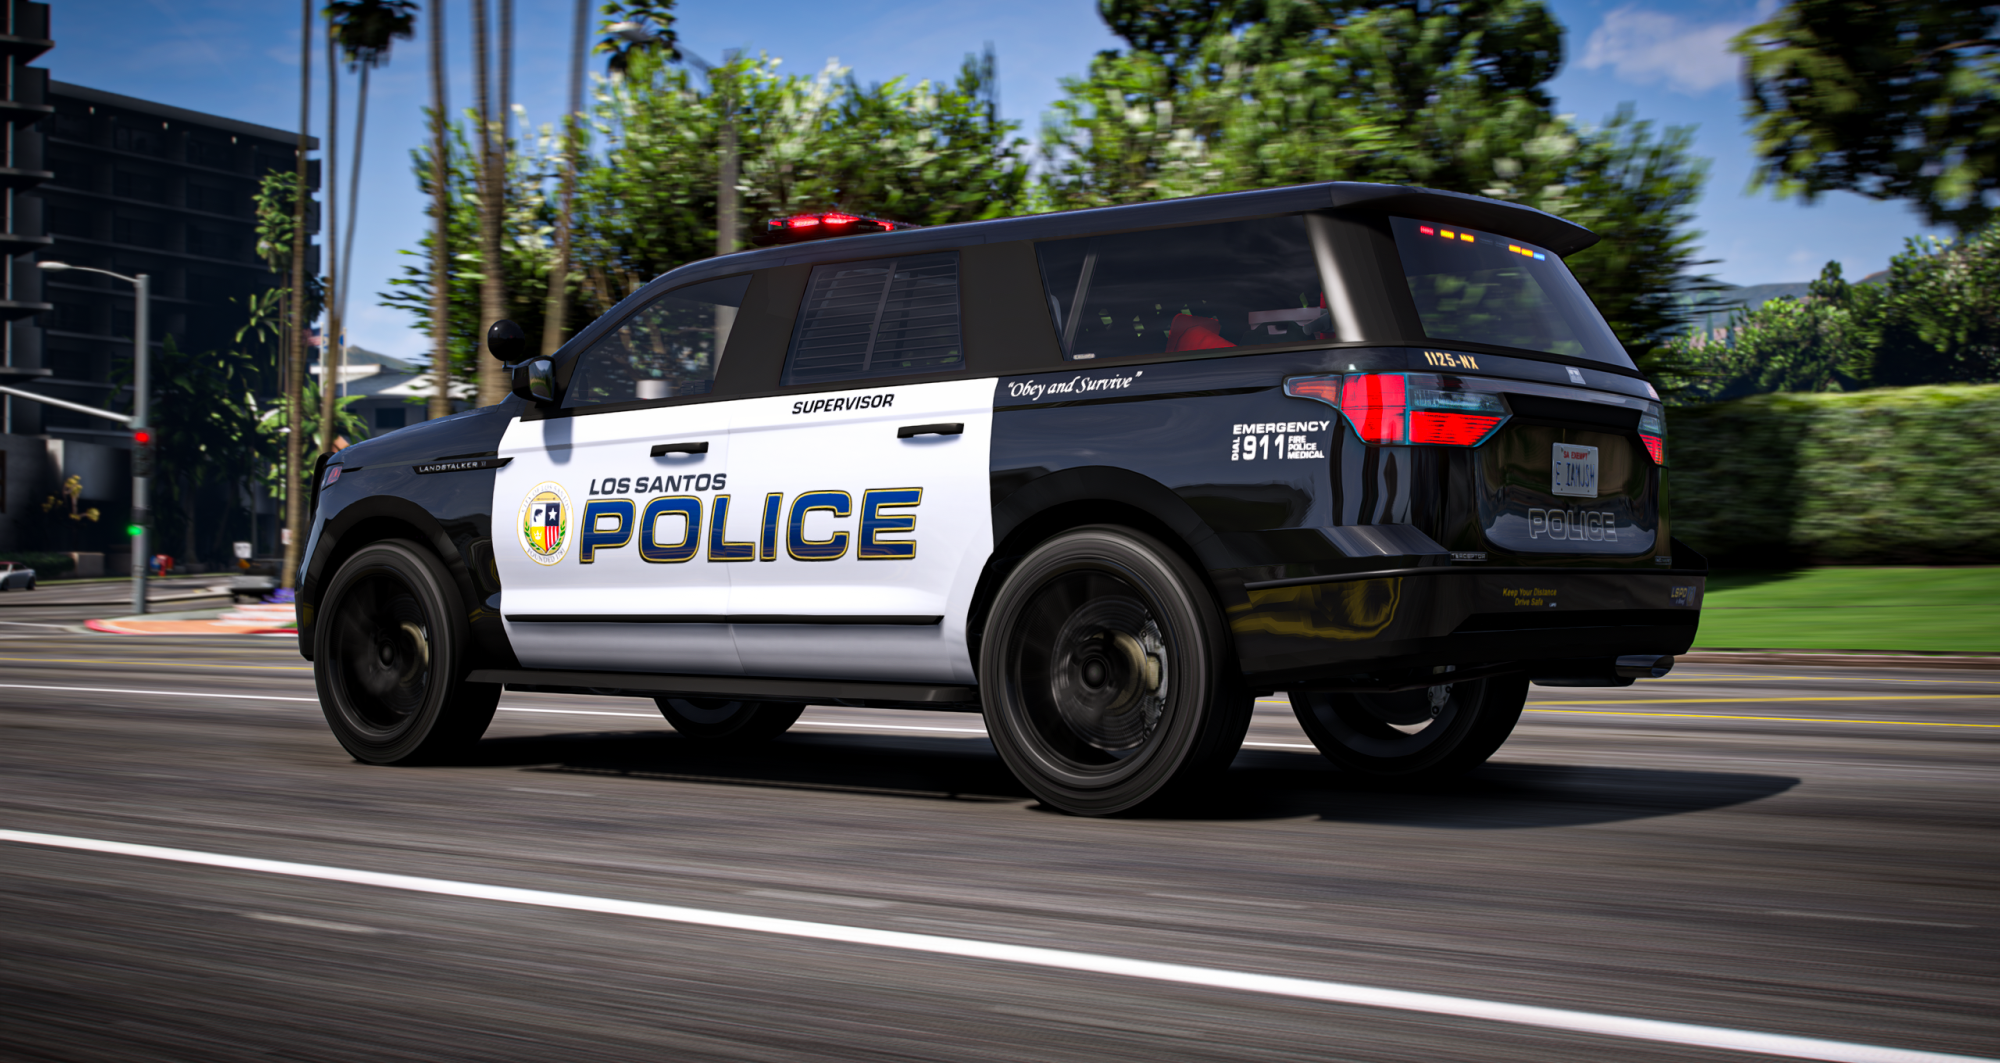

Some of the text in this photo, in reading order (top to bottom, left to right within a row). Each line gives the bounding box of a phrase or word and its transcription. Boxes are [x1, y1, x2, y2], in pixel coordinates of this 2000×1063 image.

[1424, 351, 1479, 370] 1125-NX
[1047, 378, 1074, 395] and
[791, 393, 895, 415] SUPERVISOR
[1232, 420, 1330, 435] EMERGENCY
[1242, 434, 1285, 461] 911
[1288, 435, 1307, 443] FIRE
[1288, 442, 1317, 451] POLICE
[1231, 436, 1240, 461] DIAL
[1287, 450, 1325, 459] MEDICAL
[419, 461, 478, 473] LANDSTALKER
[1556, 461, 1561, 486] E
[589, 472, 727, 496] LOS SANTOS
[579, 487, 923, 565] POLICE
[1528, 508, 1618, 542] POLICE
[527, 548, 555, 563] FOUNDED
[1502, 587, 1558, 598] Keep Your Distance
[1514, 597, 1530, 606] Drive
[1531, 597, 1544, 606] Safe
